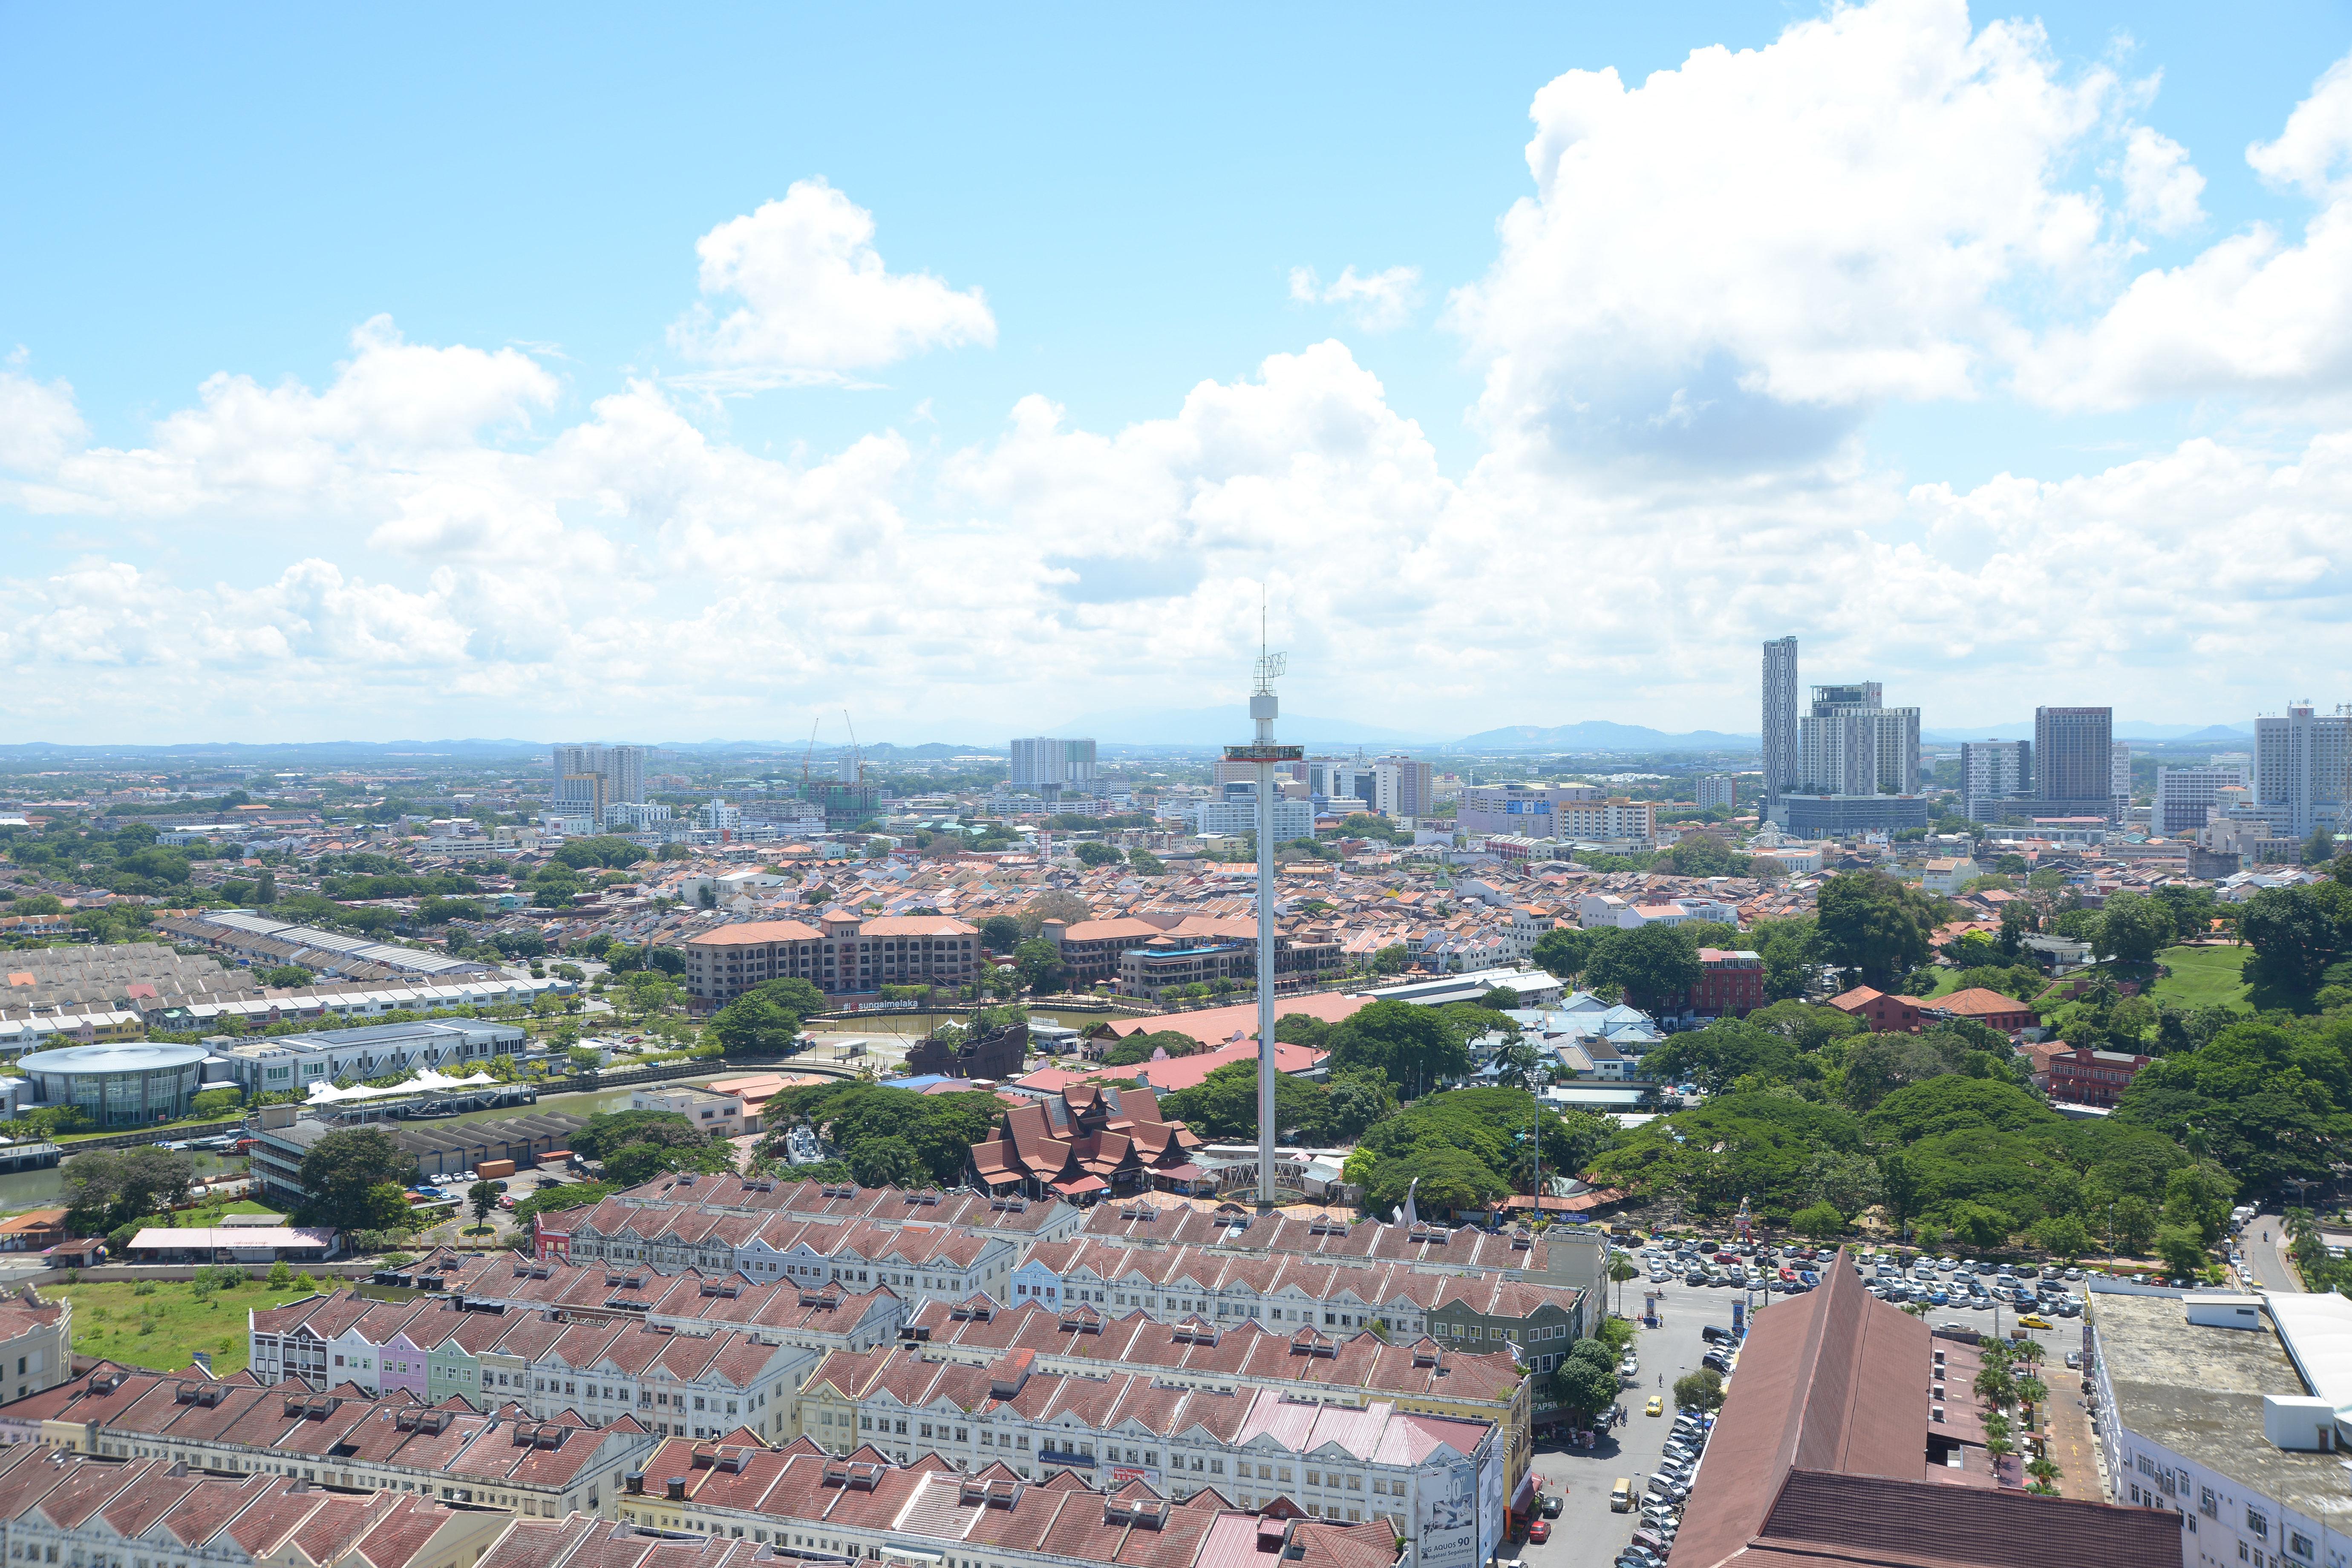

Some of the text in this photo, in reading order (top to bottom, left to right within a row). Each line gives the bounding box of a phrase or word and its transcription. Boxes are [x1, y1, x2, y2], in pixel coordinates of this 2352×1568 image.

[1536, 1401, 1558, 1412] APSK
[1434, 1542, 1456, 1551] AQUOS
[1421, 1552, 1447, 1561] Mengatasi
[1447, 1547, 1474, 1556] Segalanya!
